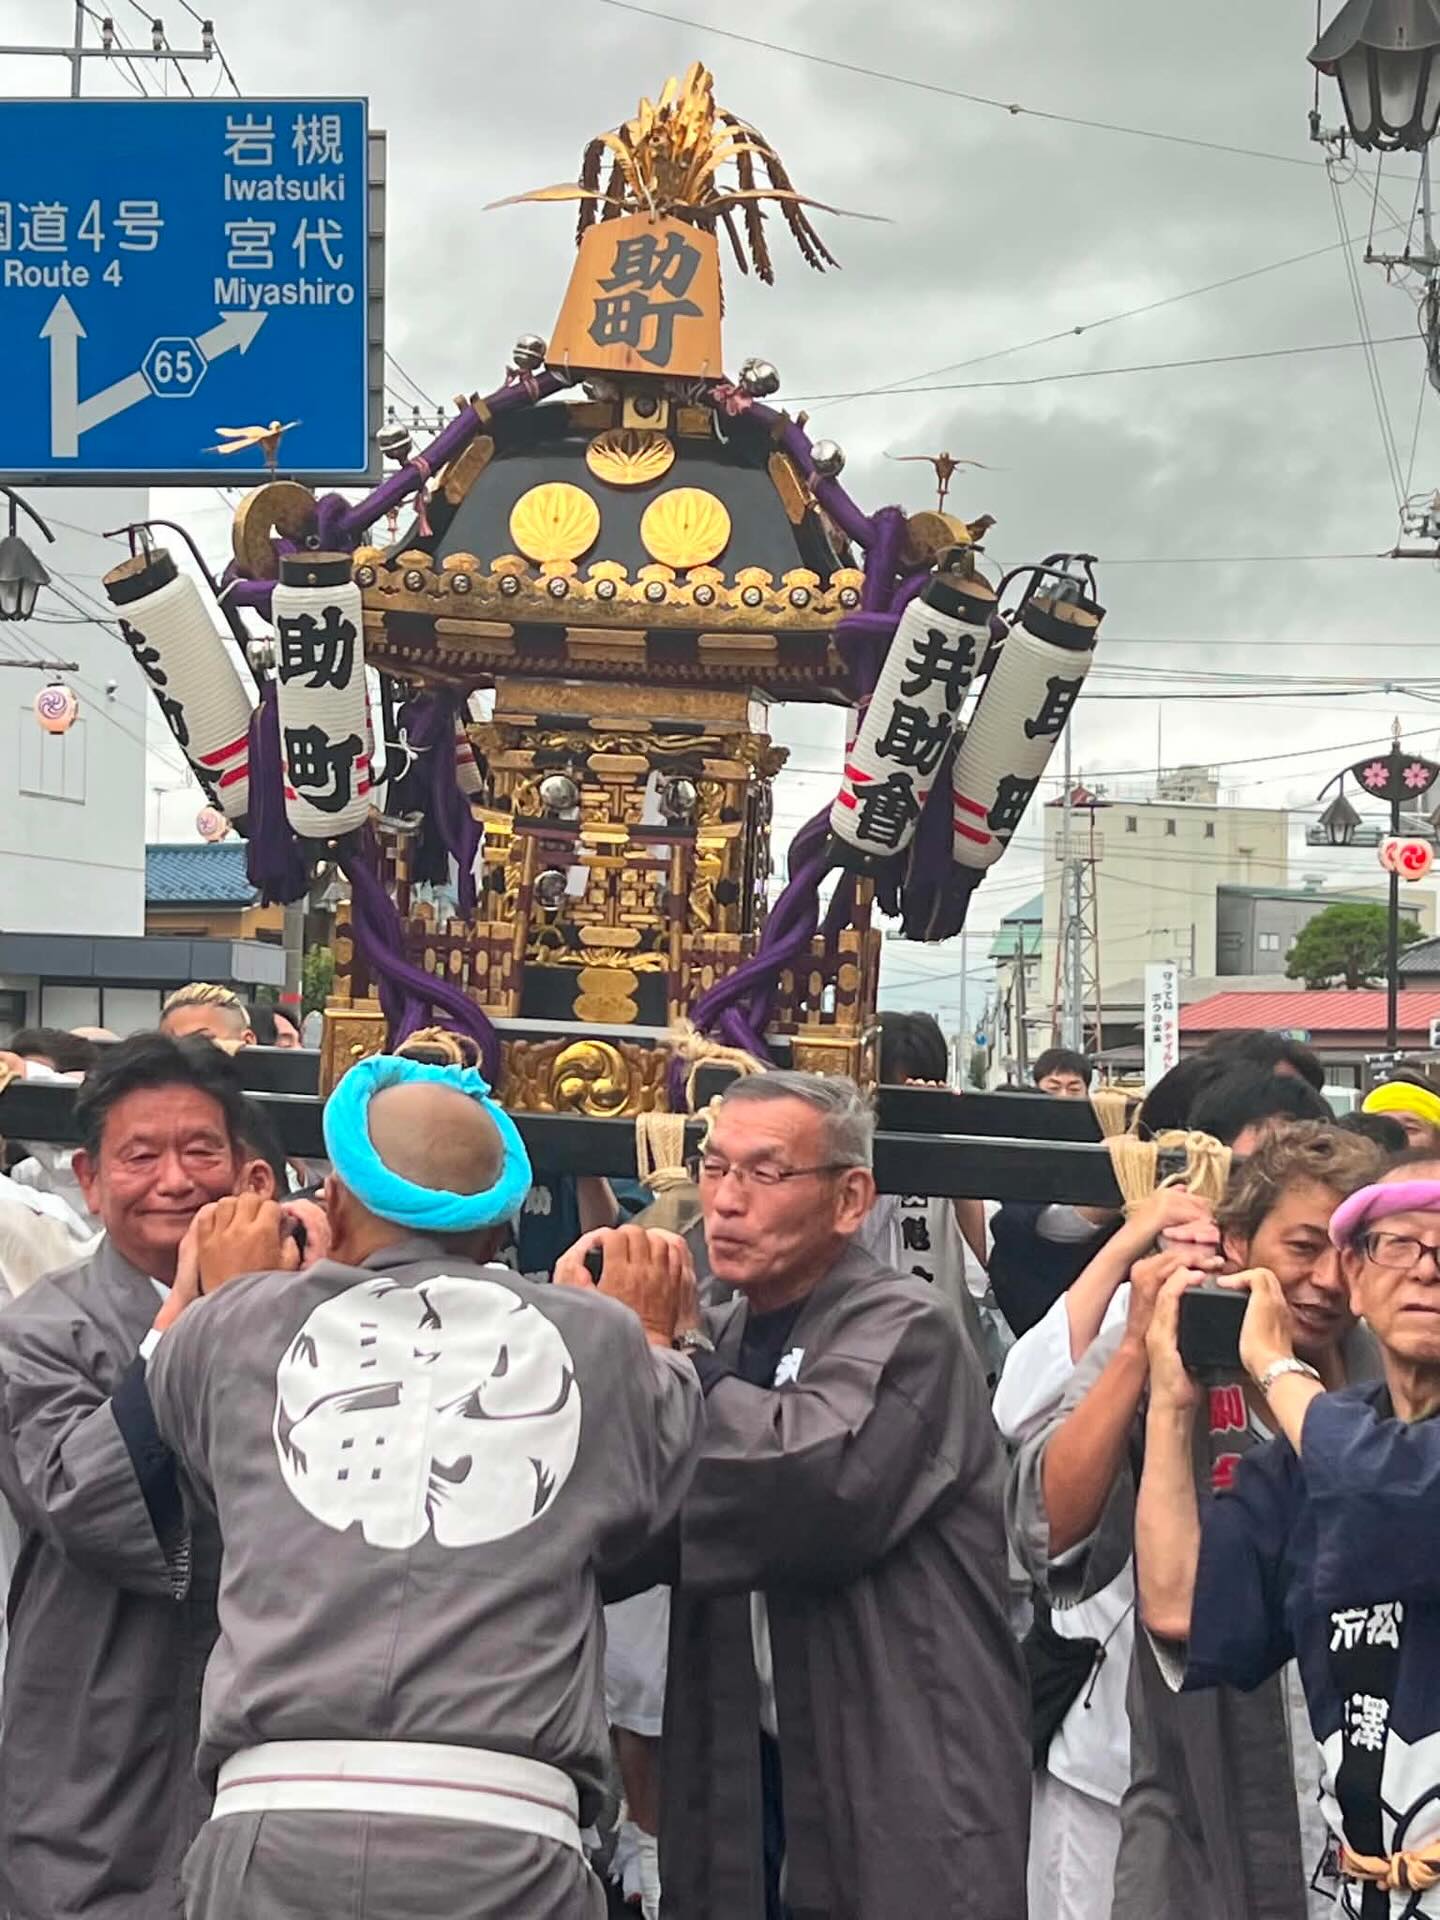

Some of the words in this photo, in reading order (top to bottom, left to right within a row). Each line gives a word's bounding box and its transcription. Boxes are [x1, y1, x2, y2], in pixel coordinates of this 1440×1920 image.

[224, 113, 343, 166] 岩槻
[224, 174, 345, 201] Iwatsuki
[0, 200, 164, 252] 道4号
[224, 217, 344, 270] 宮代
[4, 260, 89, 287] Route
[103, 260, 123, 287] 4
[214, 277, 354, 310] Miyashiro
[587, 231, 704, 368] 助町
[154, 350, 193, 383] 65
[277, 605, 364, 813] 助町
